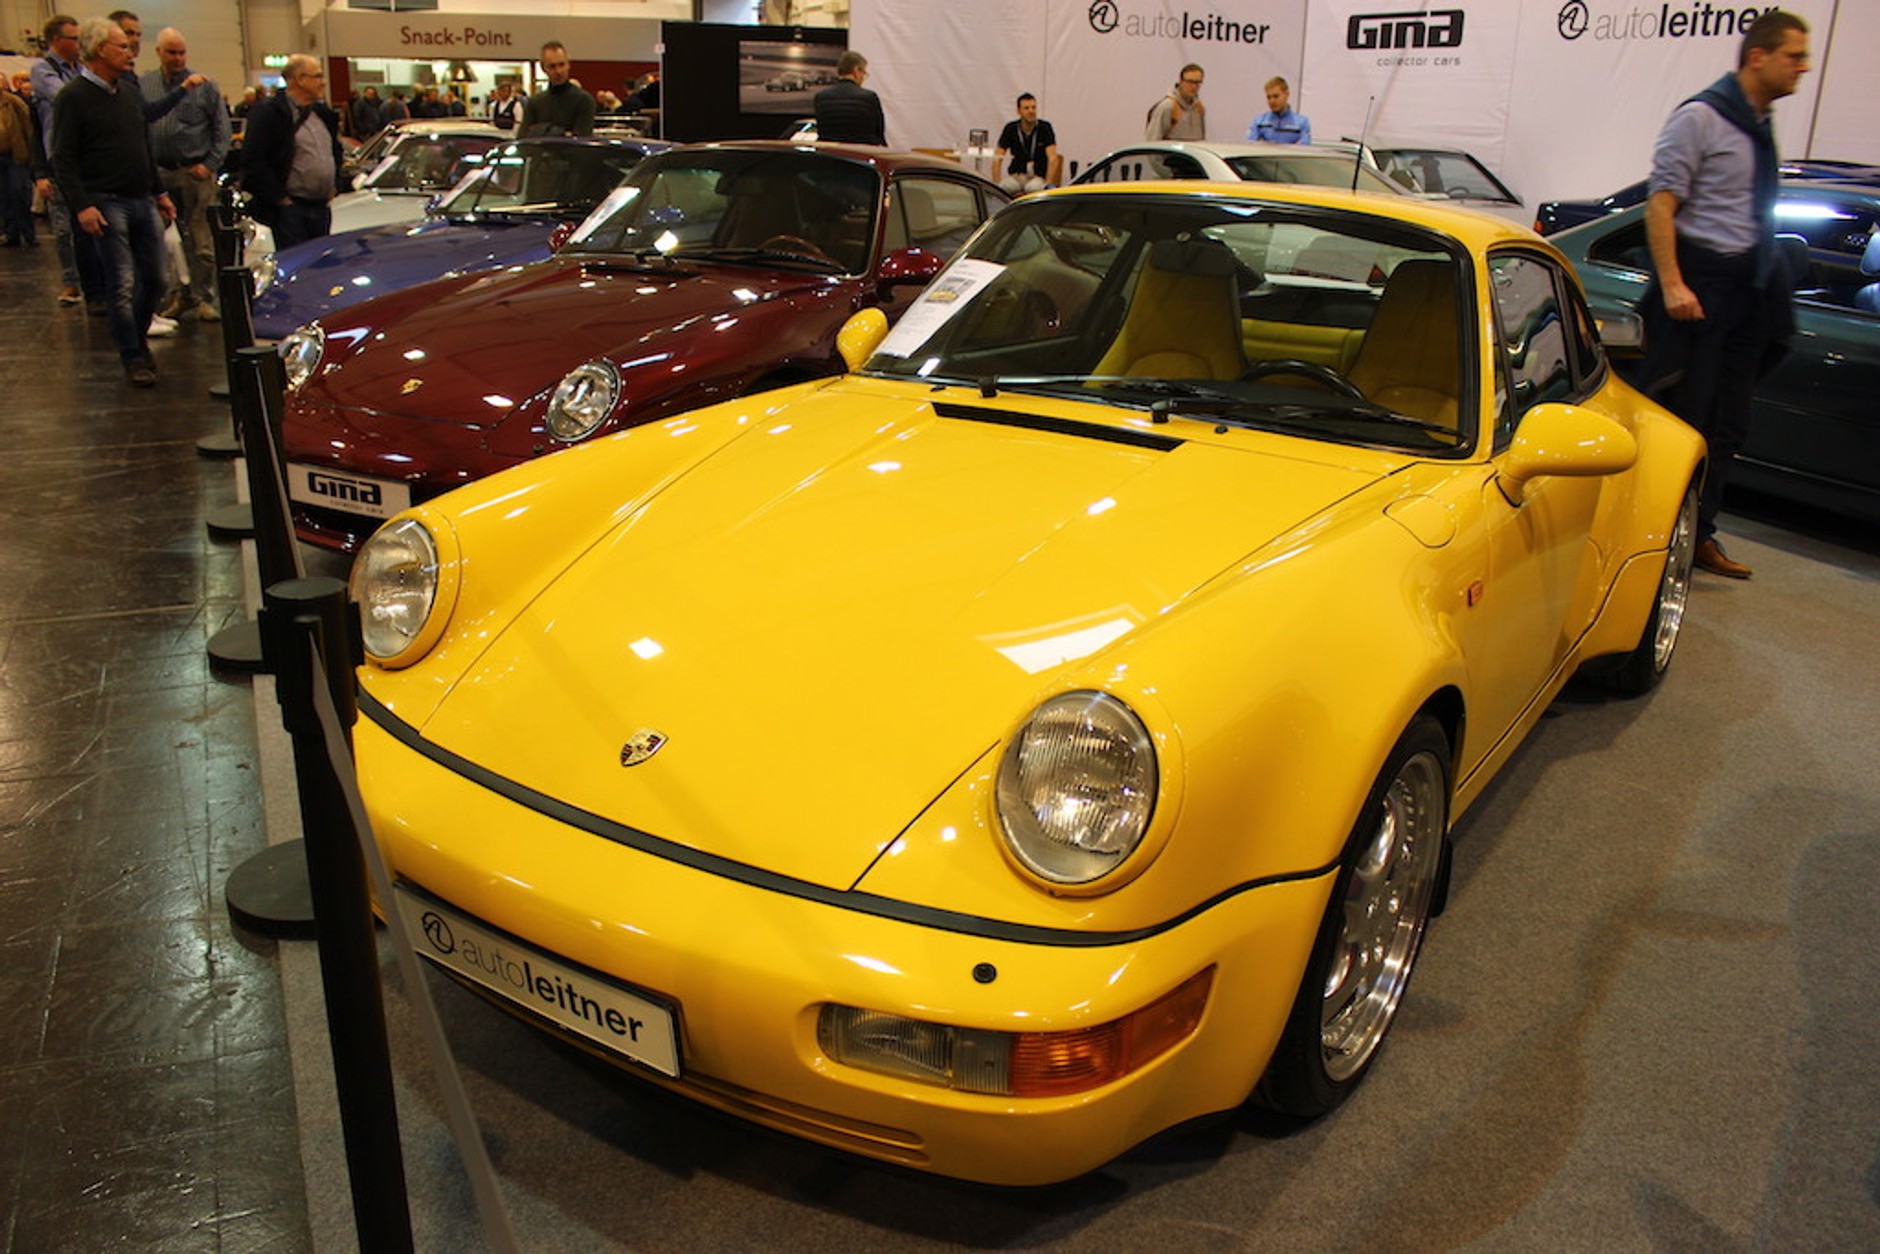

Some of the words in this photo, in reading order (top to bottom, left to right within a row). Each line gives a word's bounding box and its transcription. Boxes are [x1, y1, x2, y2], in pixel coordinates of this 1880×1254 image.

[400, 26, 512, 46] Snack-Point
[1125, 12, 1270, 43] autoleitner
[1347, 9, 1464, 49] Gina
[1433, 57, 1461, 66] cars
[462, 939, 643, 1042] autoleitner
